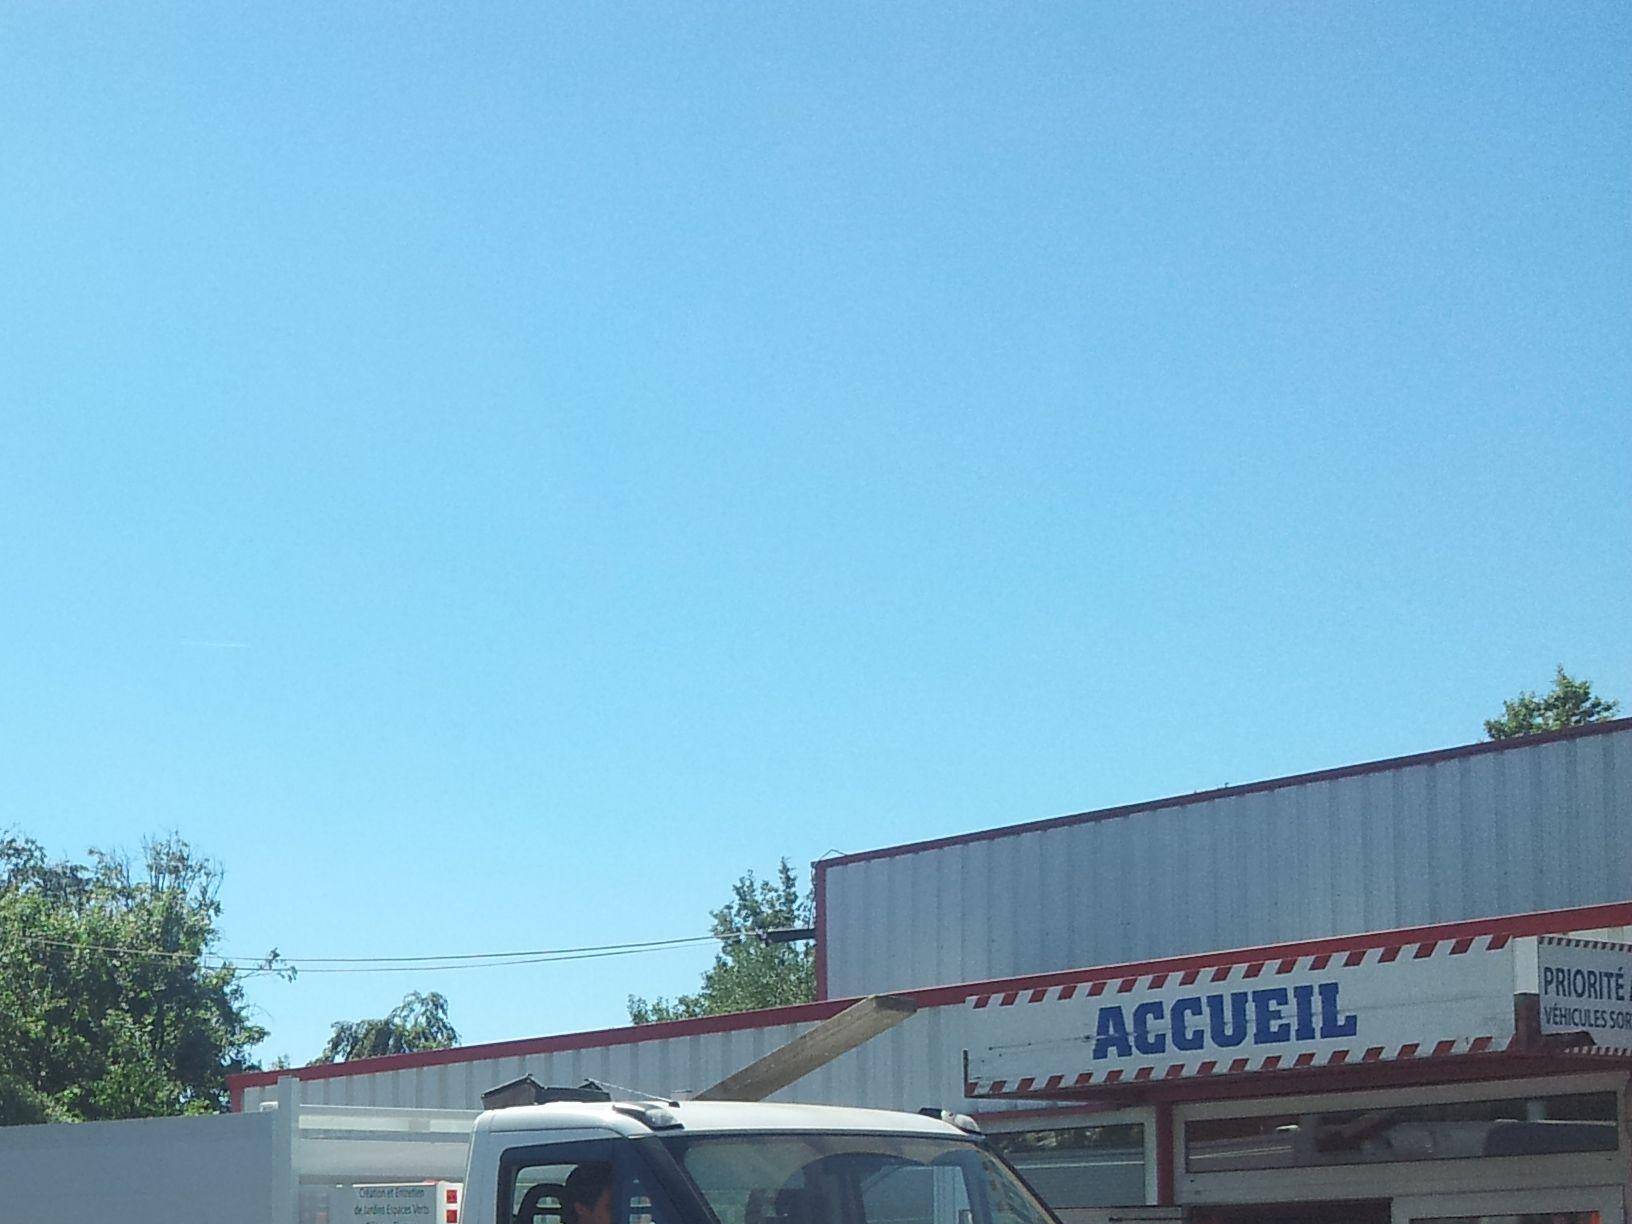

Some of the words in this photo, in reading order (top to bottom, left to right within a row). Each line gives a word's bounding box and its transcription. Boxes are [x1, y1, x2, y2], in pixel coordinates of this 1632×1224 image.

[1543, 967, 1625, 1001] PRIORITÉ
[1092, 982, 1357, 1060] ACCUEIL
[1543, 1002, 1607, 1028] VÉHICULES
[387, 1188, 394, 1198] et
[354, 1204, 362, 1215] de
[386, 1204, 411, 1216] Espaces
[412, 1204, 430, 1215] Verts
